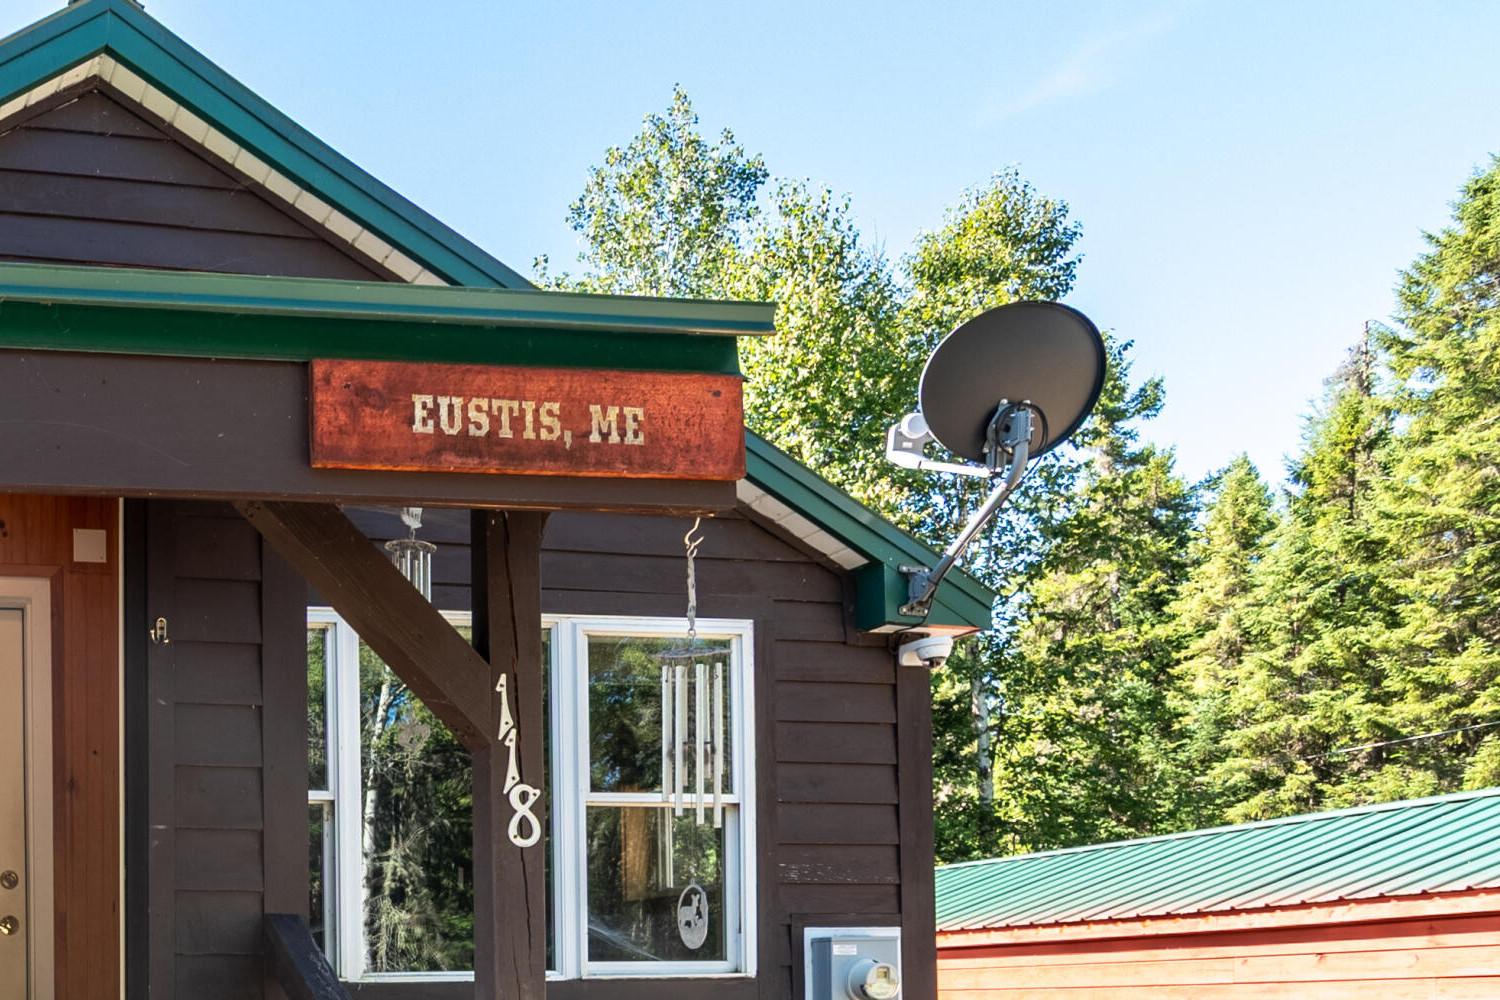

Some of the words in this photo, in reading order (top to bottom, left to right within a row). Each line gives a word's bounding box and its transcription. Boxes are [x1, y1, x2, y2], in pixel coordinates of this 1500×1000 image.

[412, 394, 572, 451] EUSTIS,
[589, 404, 645, 446] ME
[495, 672, 542, 848] 118
